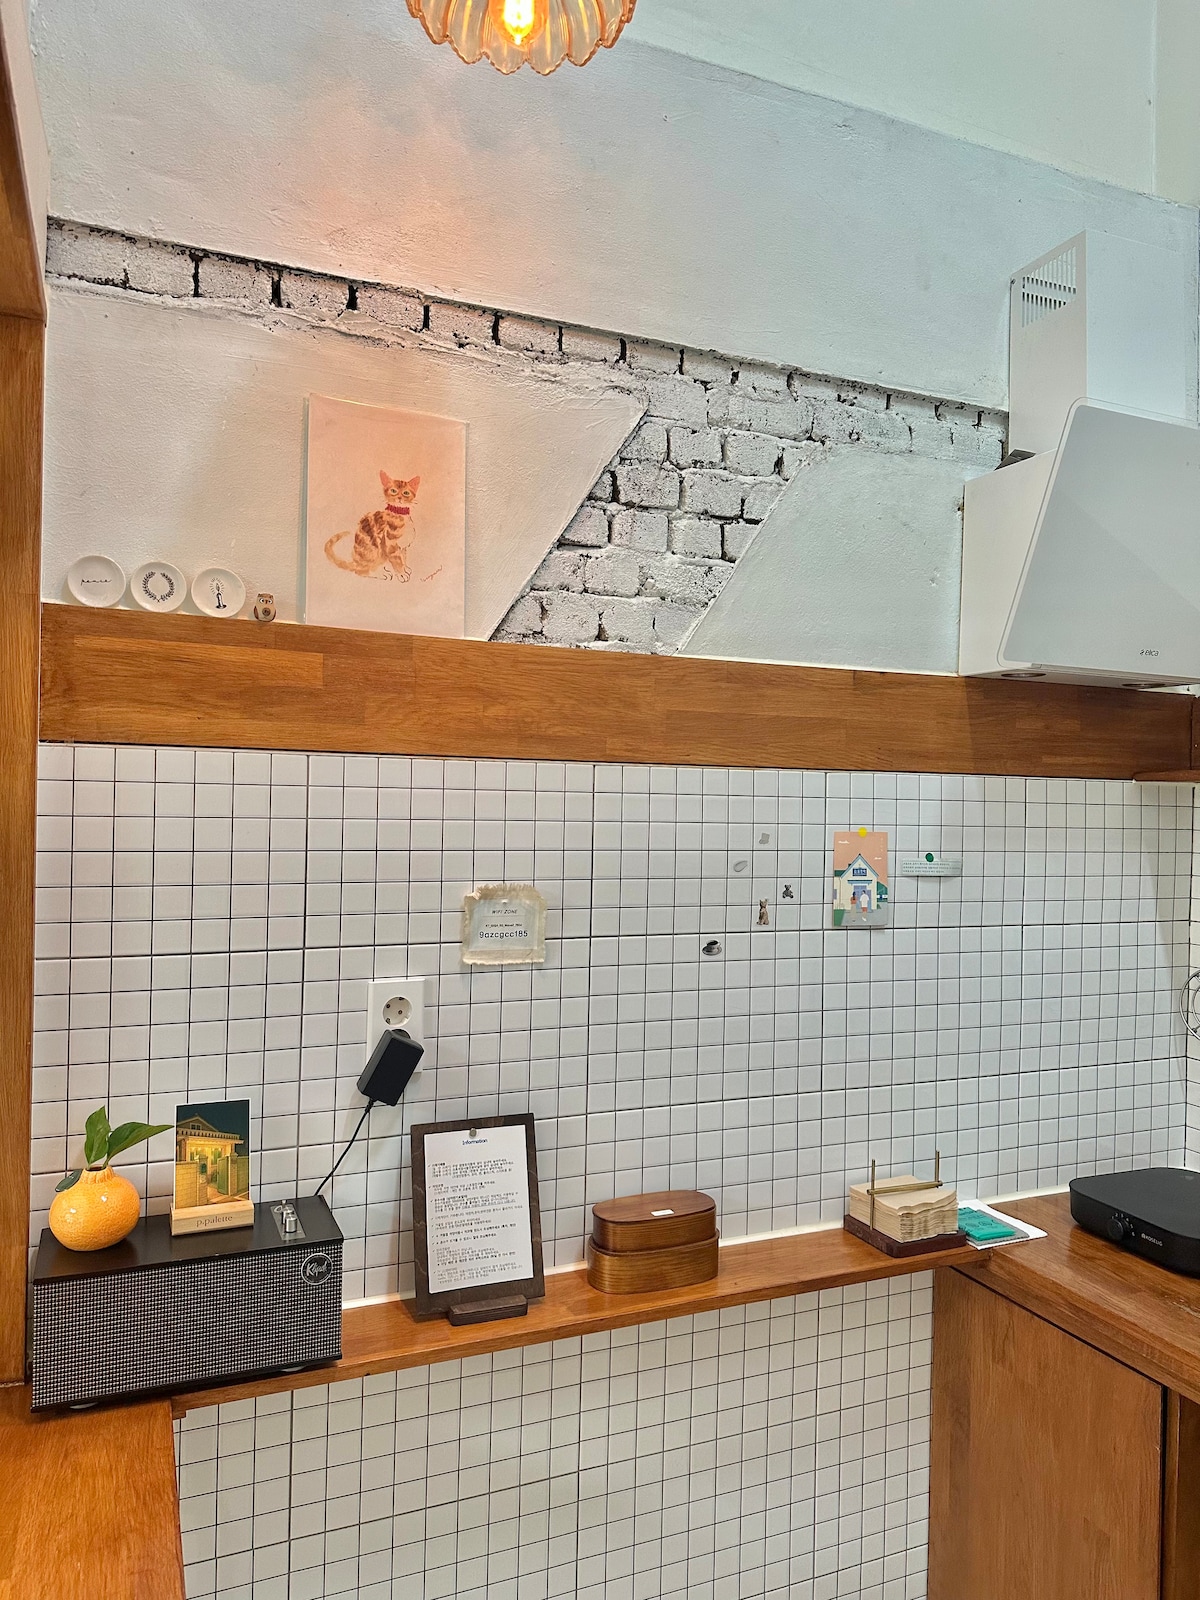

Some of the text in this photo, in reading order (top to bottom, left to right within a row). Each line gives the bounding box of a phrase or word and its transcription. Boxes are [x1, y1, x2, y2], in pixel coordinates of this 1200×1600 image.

[1144, 649, 1159, 657] elica
[479, 929, 528, 939] 9azcgcc185
[462, 1138, 488, 1146] Information
